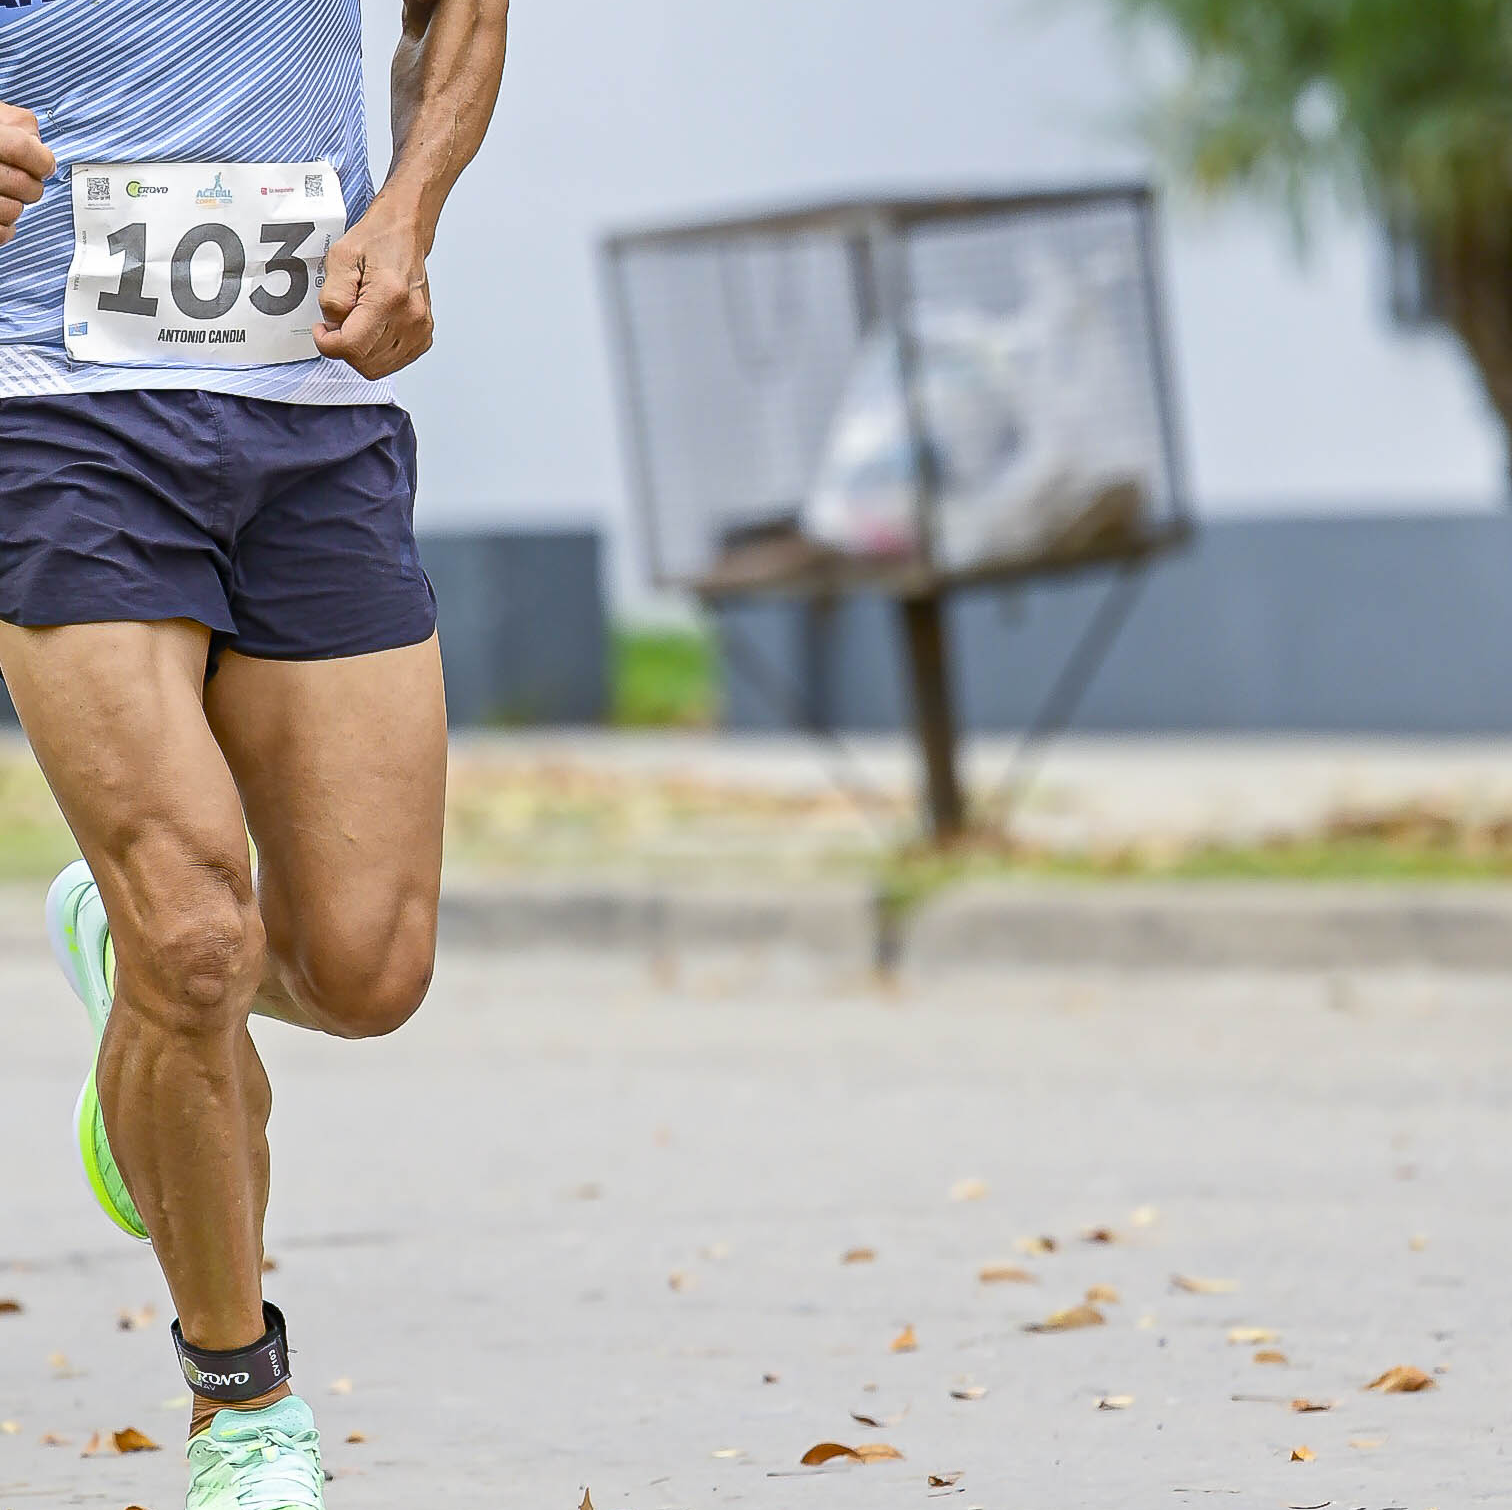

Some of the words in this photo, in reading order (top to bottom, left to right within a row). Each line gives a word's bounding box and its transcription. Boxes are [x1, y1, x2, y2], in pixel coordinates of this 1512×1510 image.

[97, 222, 316, 320] 103
[157, 329, 206, 344] ANTONIO
[208, 329, 246, 344] CANDIA
[268, 1349, 281, 1377] CV103
